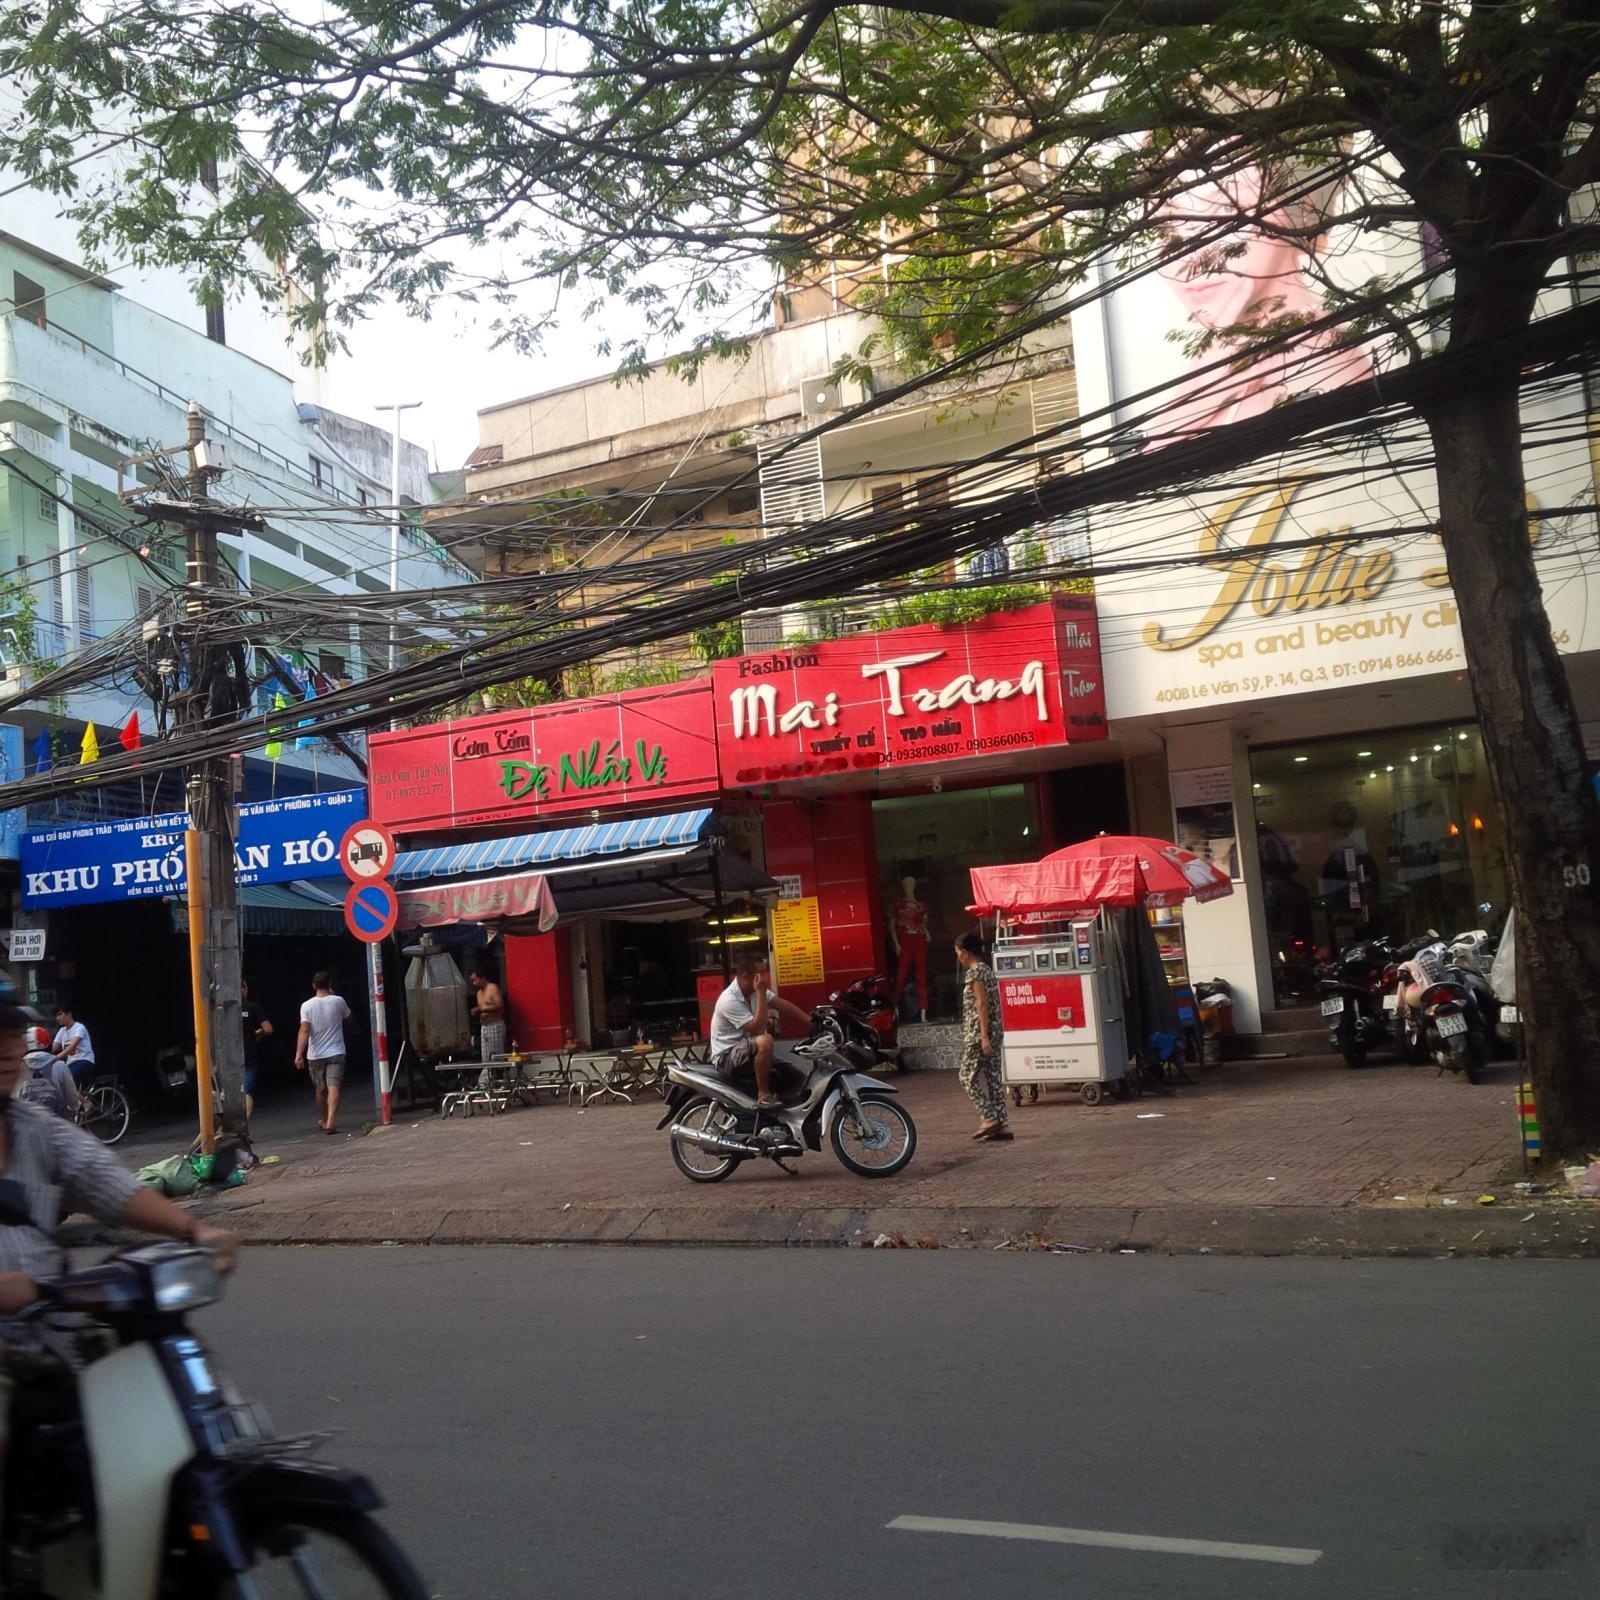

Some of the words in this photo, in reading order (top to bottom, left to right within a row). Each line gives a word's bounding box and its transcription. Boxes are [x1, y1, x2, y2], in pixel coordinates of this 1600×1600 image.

[1198, 641, 1244, 668] spa
[1254, 625, 1305, 654] and
[1315, 611, 1413, 645] beauty
[737, 654, 820, 678] Fashion
[1396, 653, 1423, 668] 866
[730, 684, 839, 739] Mai
[861, 650, 1049, 721] Trang
[497, 760, 556, 800] Đệ
[559, 740, 632, 793] Nhất
[635, 740, 668, 786] Vị
[32, 835, 45, 843] BAN
[58, 831, 71, 841] ĐẠO
[73, 829, 94, 838] PHONG
[96, 825, 112, 835] TRÀO
[313, 798, 321, 807] 14
[327, 796, 346, 806] QUẬN
[347, 794, 353, 803] 3
[26, 865, 101, 896] KHU
[112, 845, 185, 886] PHỐ
[282, 830, 338, 866] HÓ
[1563, 863, 1590, 887] 50
[14, 948, 24, 956] BIA
[15, 936, 27, 945] BIA
